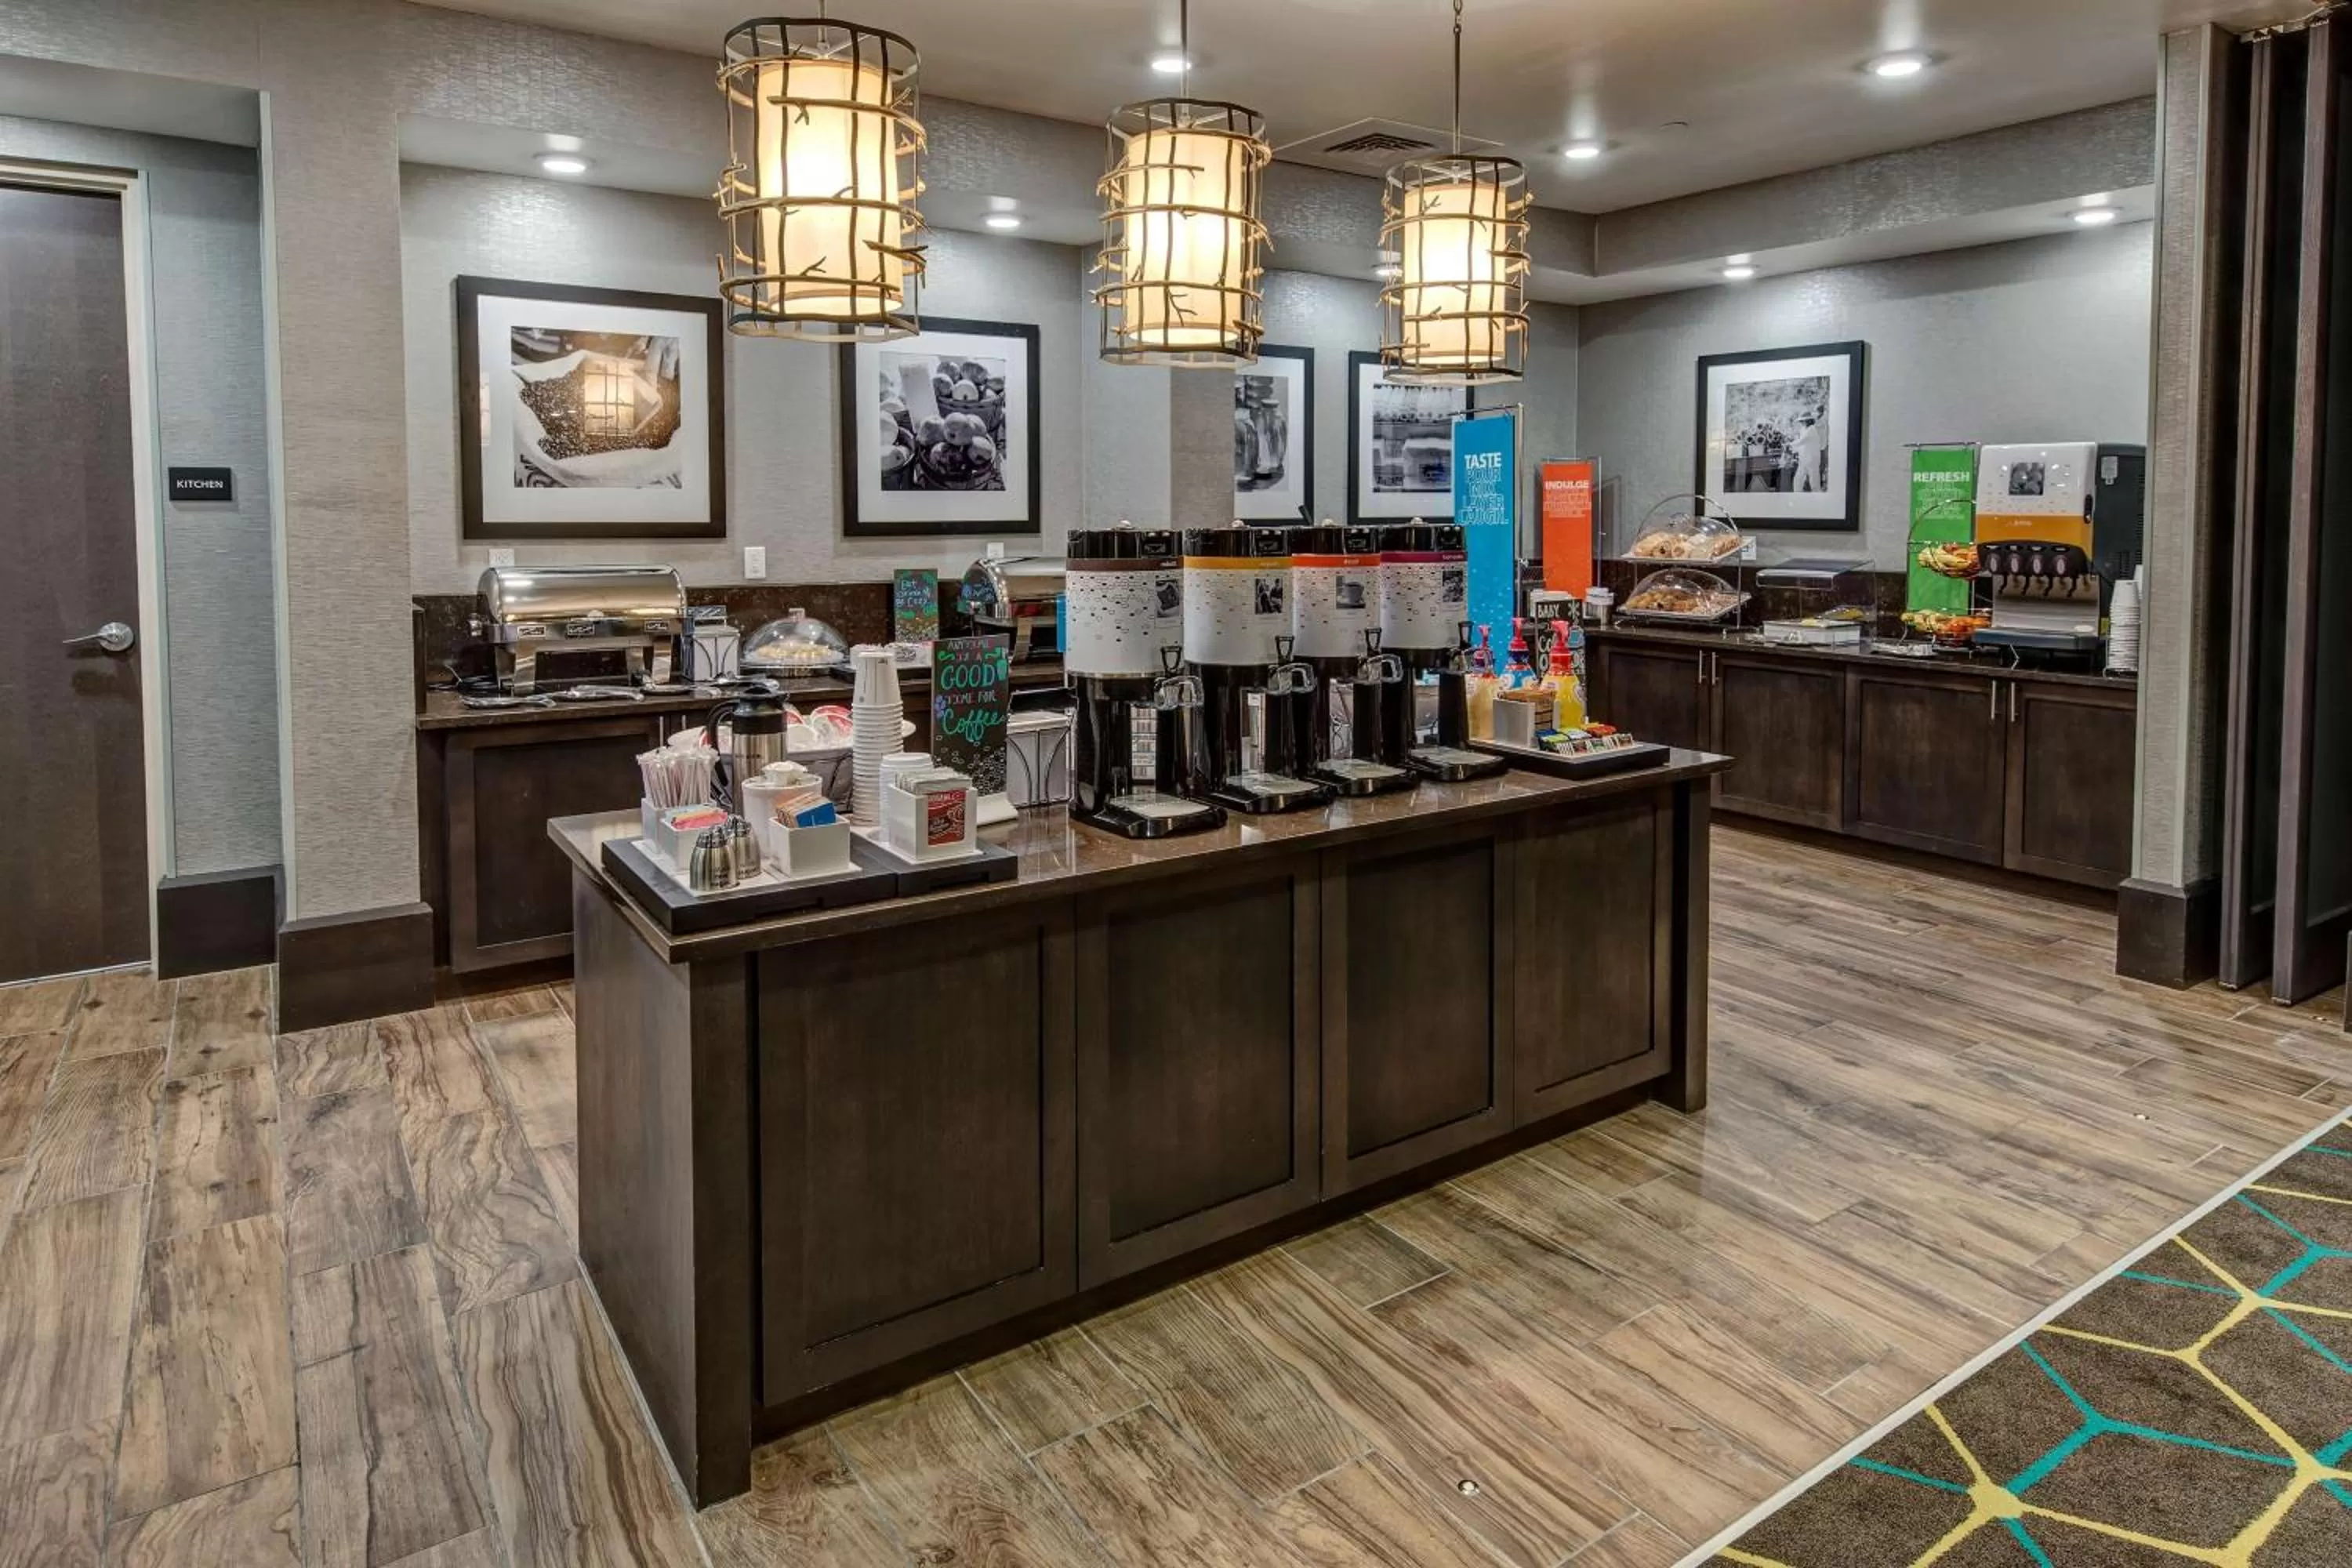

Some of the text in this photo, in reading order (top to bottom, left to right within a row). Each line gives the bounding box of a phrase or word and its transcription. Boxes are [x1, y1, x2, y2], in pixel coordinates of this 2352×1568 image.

[1464, 452, 1502, 469] TASTE
[176, 479, 223, 488] KITCHEN
[1913, 471, 1970, 482] REFRESH
[1545, 480, 1589, 489] INDULGE
[941, 663, 996, 690] GOOD
[943, 707, 1007, 742] Coffee
